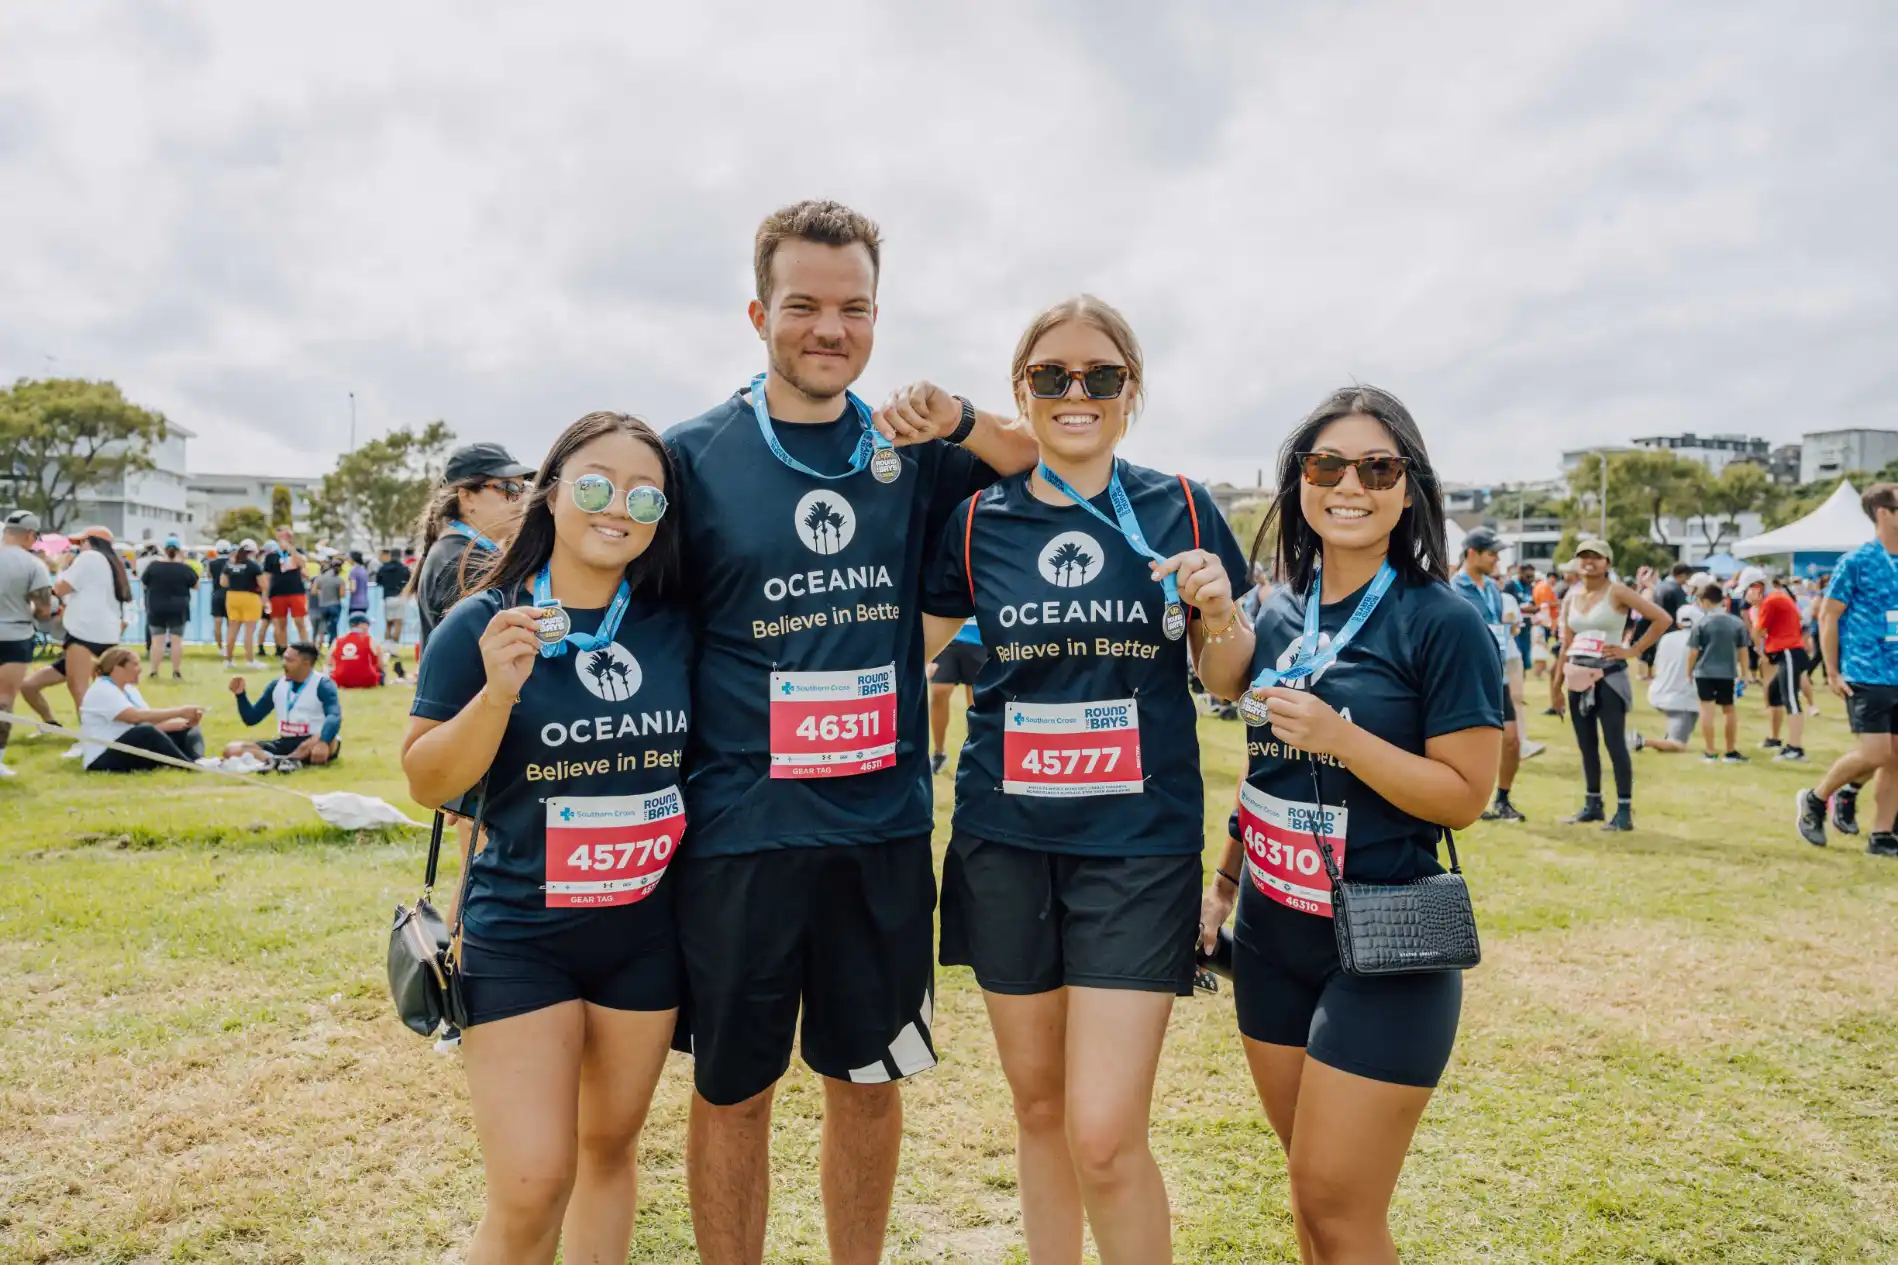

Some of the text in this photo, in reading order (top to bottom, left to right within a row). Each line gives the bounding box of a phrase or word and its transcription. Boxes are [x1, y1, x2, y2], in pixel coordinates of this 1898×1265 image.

[763, 565, 893, 601] OCEANIA
[752, 611, 827, 639] Believe
[832, 606, 852, 625] in
[998, 600, 1149, 628] OCEANIA
[995, 637, 1160, 664] Believe in Better
[857, 672, 889, 685] ROUND
[862, 681, 890, 696] BAYS
[1084, 706, 1127, 718] ROUND
[541, 709, 688, 747] OCEANIA
[795, 711, 879, 741] 46311
[1090, 716, 1128, 729] BAYS
[526, 758, 610, 782] Believe
[617, 752, 636, 772] in
[860, 760, 882, 771] 46311
[1021, 747, 1121, 775] 45777
[792, 766, 832, 775] GEAR TAG
[644, 792, 677, 809] ROUND
[648, 802, 679, 820] BAYS
[1288, 807, 1335, 822] ROUND
[1292, 818, 1334, 834] BAYS
[567, 834, 672, 871] 45770
[1244, 824, 1320, 876] 46310
[1286, 896, 1319, 912] 46310
